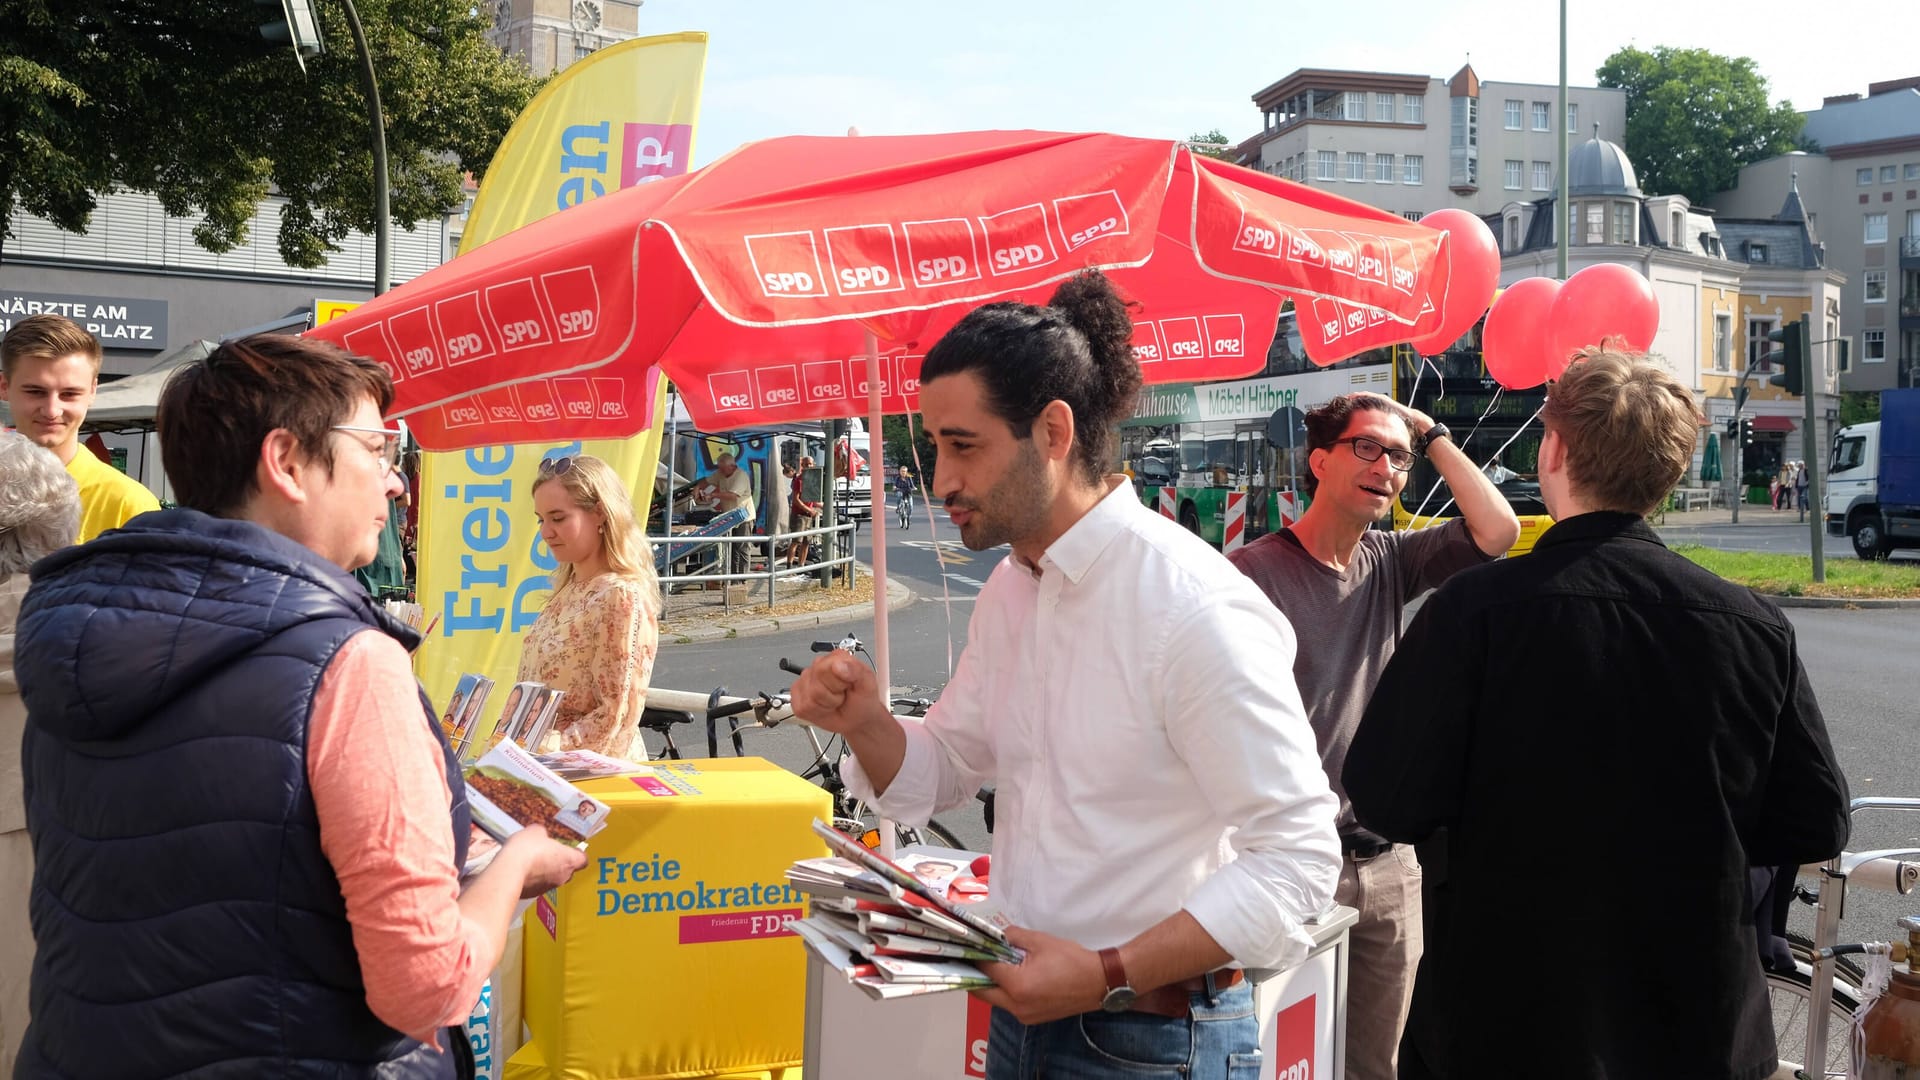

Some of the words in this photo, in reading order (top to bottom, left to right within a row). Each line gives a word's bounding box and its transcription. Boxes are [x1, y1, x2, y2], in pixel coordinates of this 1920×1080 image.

[1070, 217, 1117, 245] SPD
[1240, 226, 1276, 250] SPD
[994, 244, 1044, 270] SPD
[1291, 236, 1320, 259] SPD
[841, 266, 890, 289] SPD
[917, 256, 967, 281] SPD
[1359, 255, 1382, 277] SPD
[1394, 266, 1414, 288] SPD
[764, 272, 813, 292] SPD
[0, 297, 87, 318] NÄRZTE
[92, 305, 127, 320] AM
[87, 323, 153, 339] PLATZ
[502, 319, 541, 345] SPD
[559, 309, 593, 334] SPD
[449, 332, 483, 359] SPD
[406, 346, 434, 371] SPD
[1208, 386, 1245, 416] Möbel
[1248, 384, 1298, 413] Hübner
[443, 444, 515, 637] Freie
[597, 853, 681, 885] Freie
[597, 880, 804, 916] Demokraten
[711, 917, 749, 927] Friedenau
